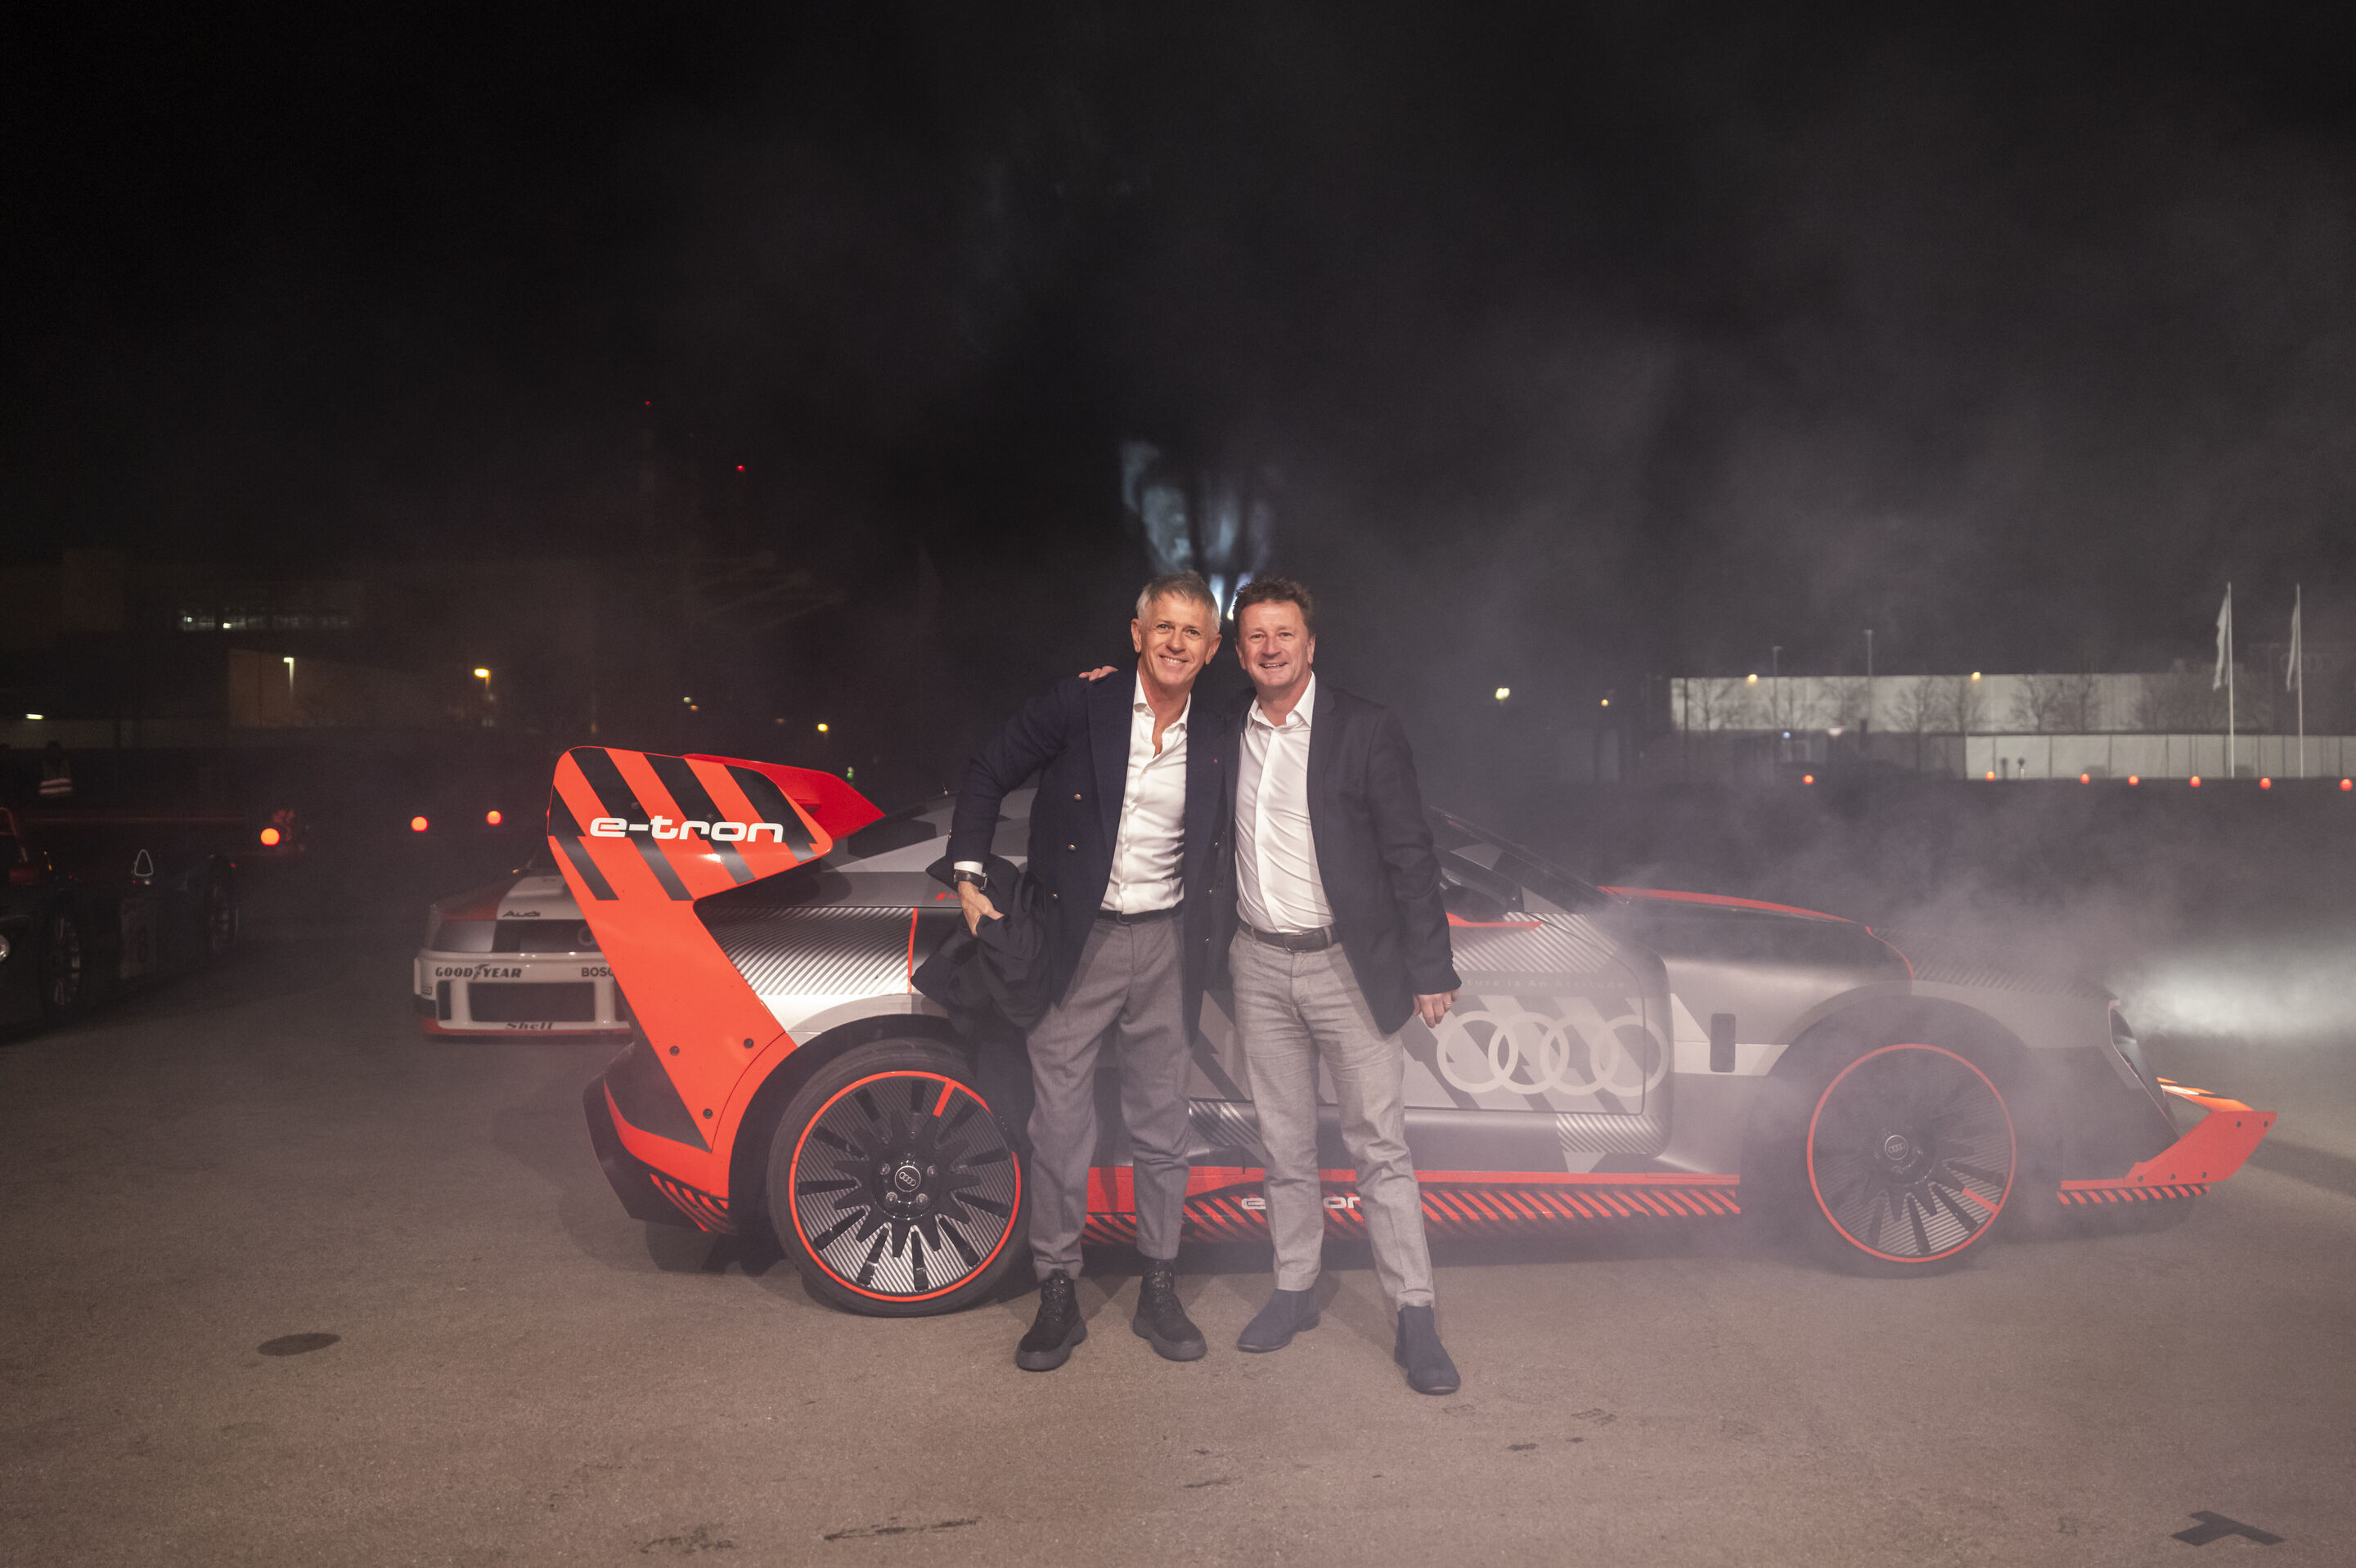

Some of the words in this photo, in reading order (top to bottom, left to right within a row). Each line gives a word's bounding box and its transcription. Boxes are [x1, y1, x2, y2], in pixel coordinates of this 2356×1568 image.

[590, 815, 784, 843] e-tron
[581, 967, 614, 977] BOSC
[1465, 978, 1501, 987] ture
[505, 1021, 554, 1030] Shell
